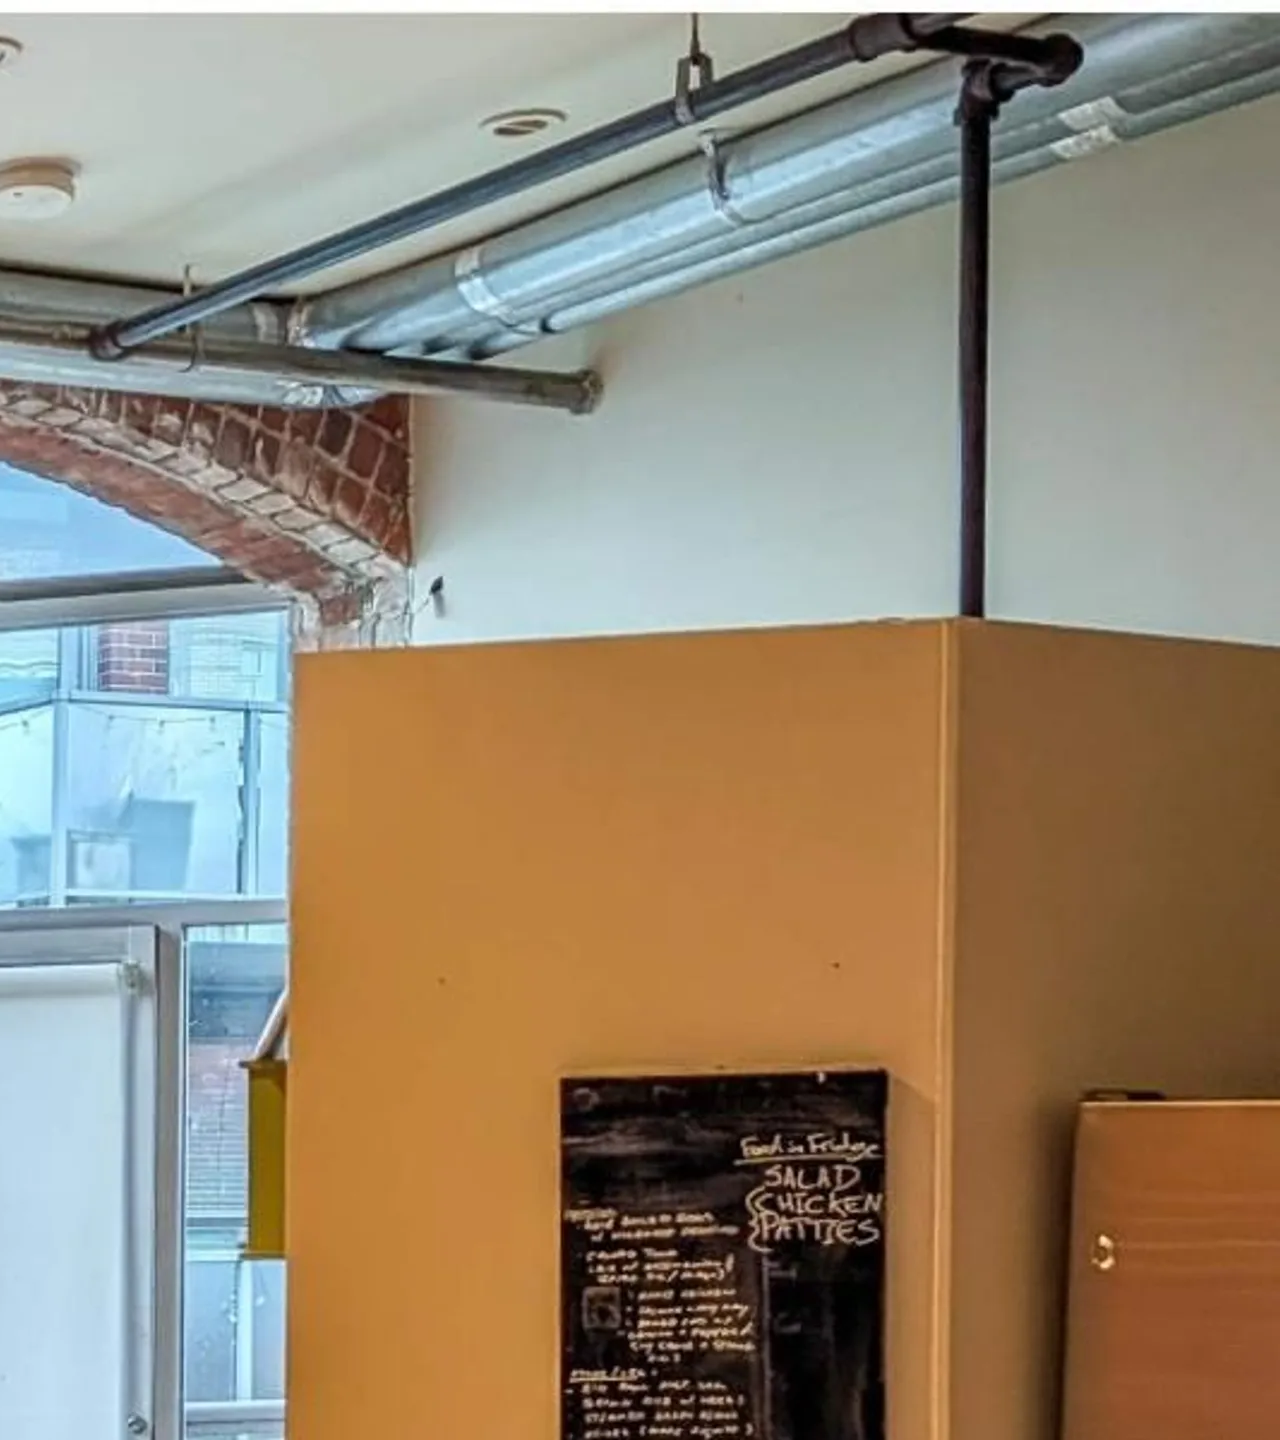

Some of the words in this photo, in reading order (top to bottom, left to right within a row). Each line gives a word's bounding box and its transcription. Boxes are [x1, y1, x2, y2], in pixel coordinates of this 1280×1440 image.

[806, 1131, 881, 1163] Fridge
[763, 1163, 862, 1193] SALAD
[754, 1190, 884, 1218] CHICKEN
[758, 1212, 881, 1247] PATTIES
